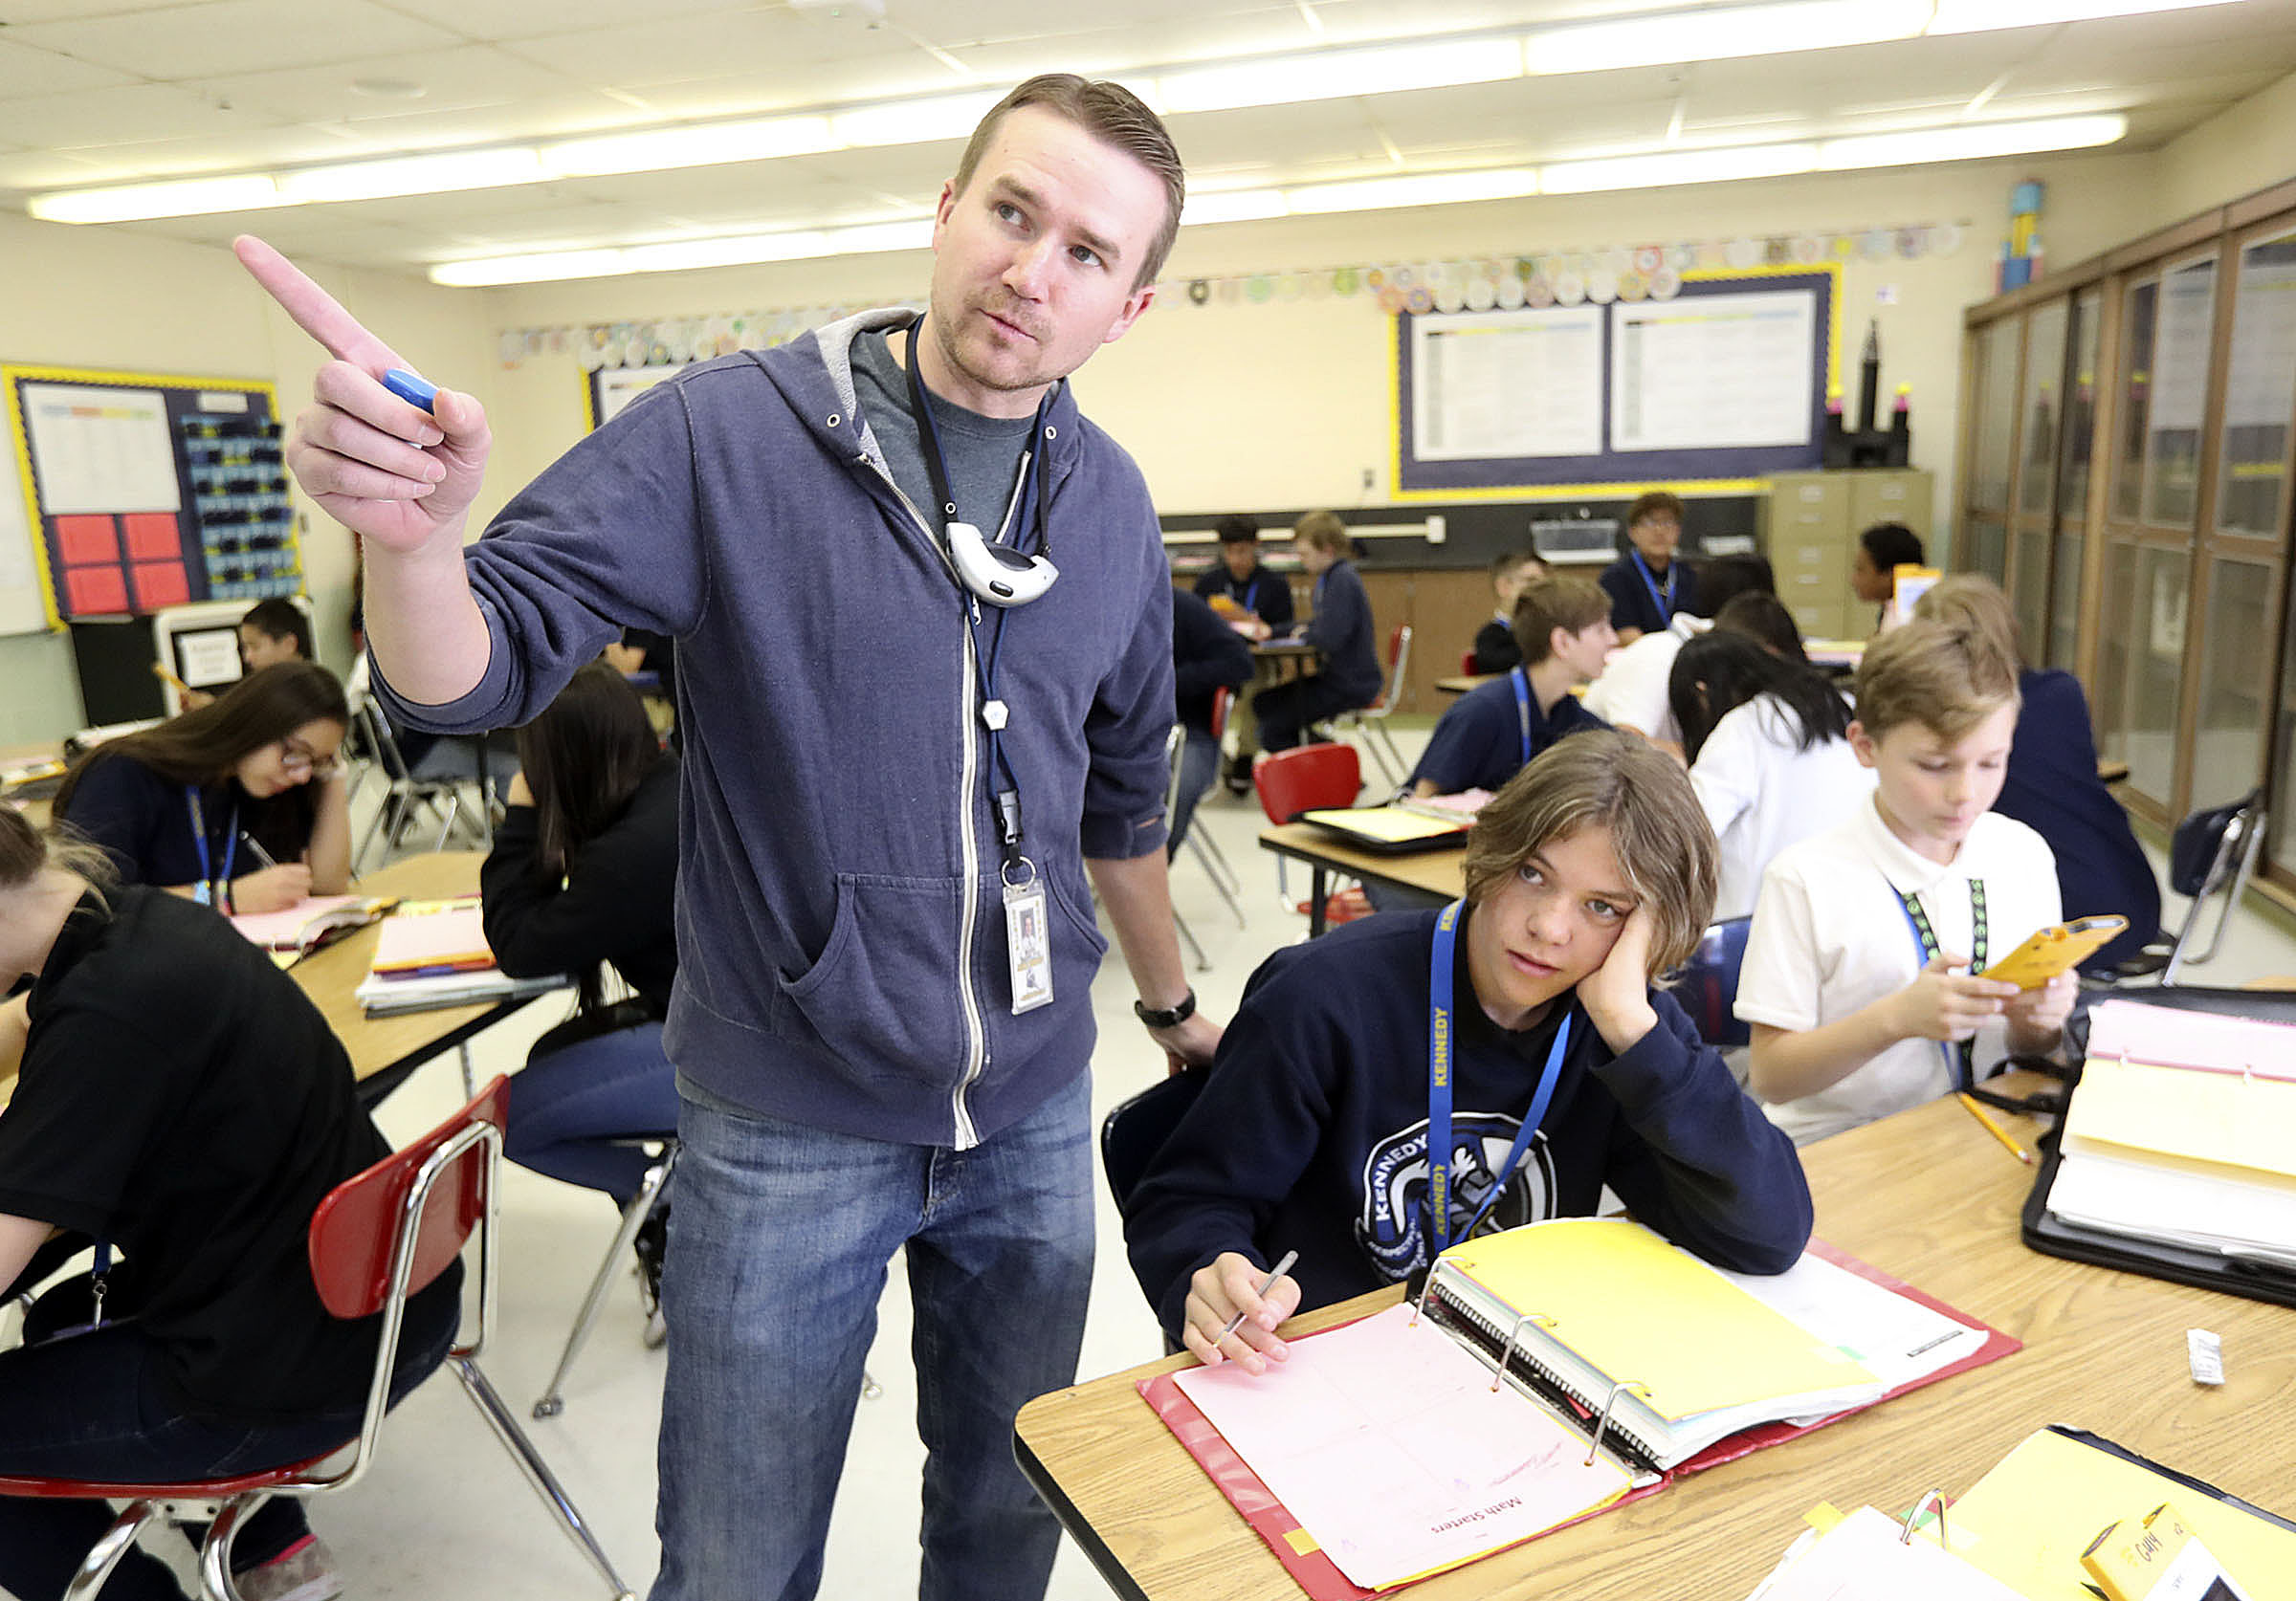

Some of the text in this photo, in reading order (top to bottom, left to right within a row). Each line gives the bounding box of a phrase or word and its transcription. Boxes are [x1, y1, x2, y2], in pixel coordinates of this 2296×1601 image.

[1434, 1007, 1448, 1086] KENNEDY
[1375, 1132, 1428, 1221] KENNEDY
[1430, 1497, 1523, 1534] Math Starters
